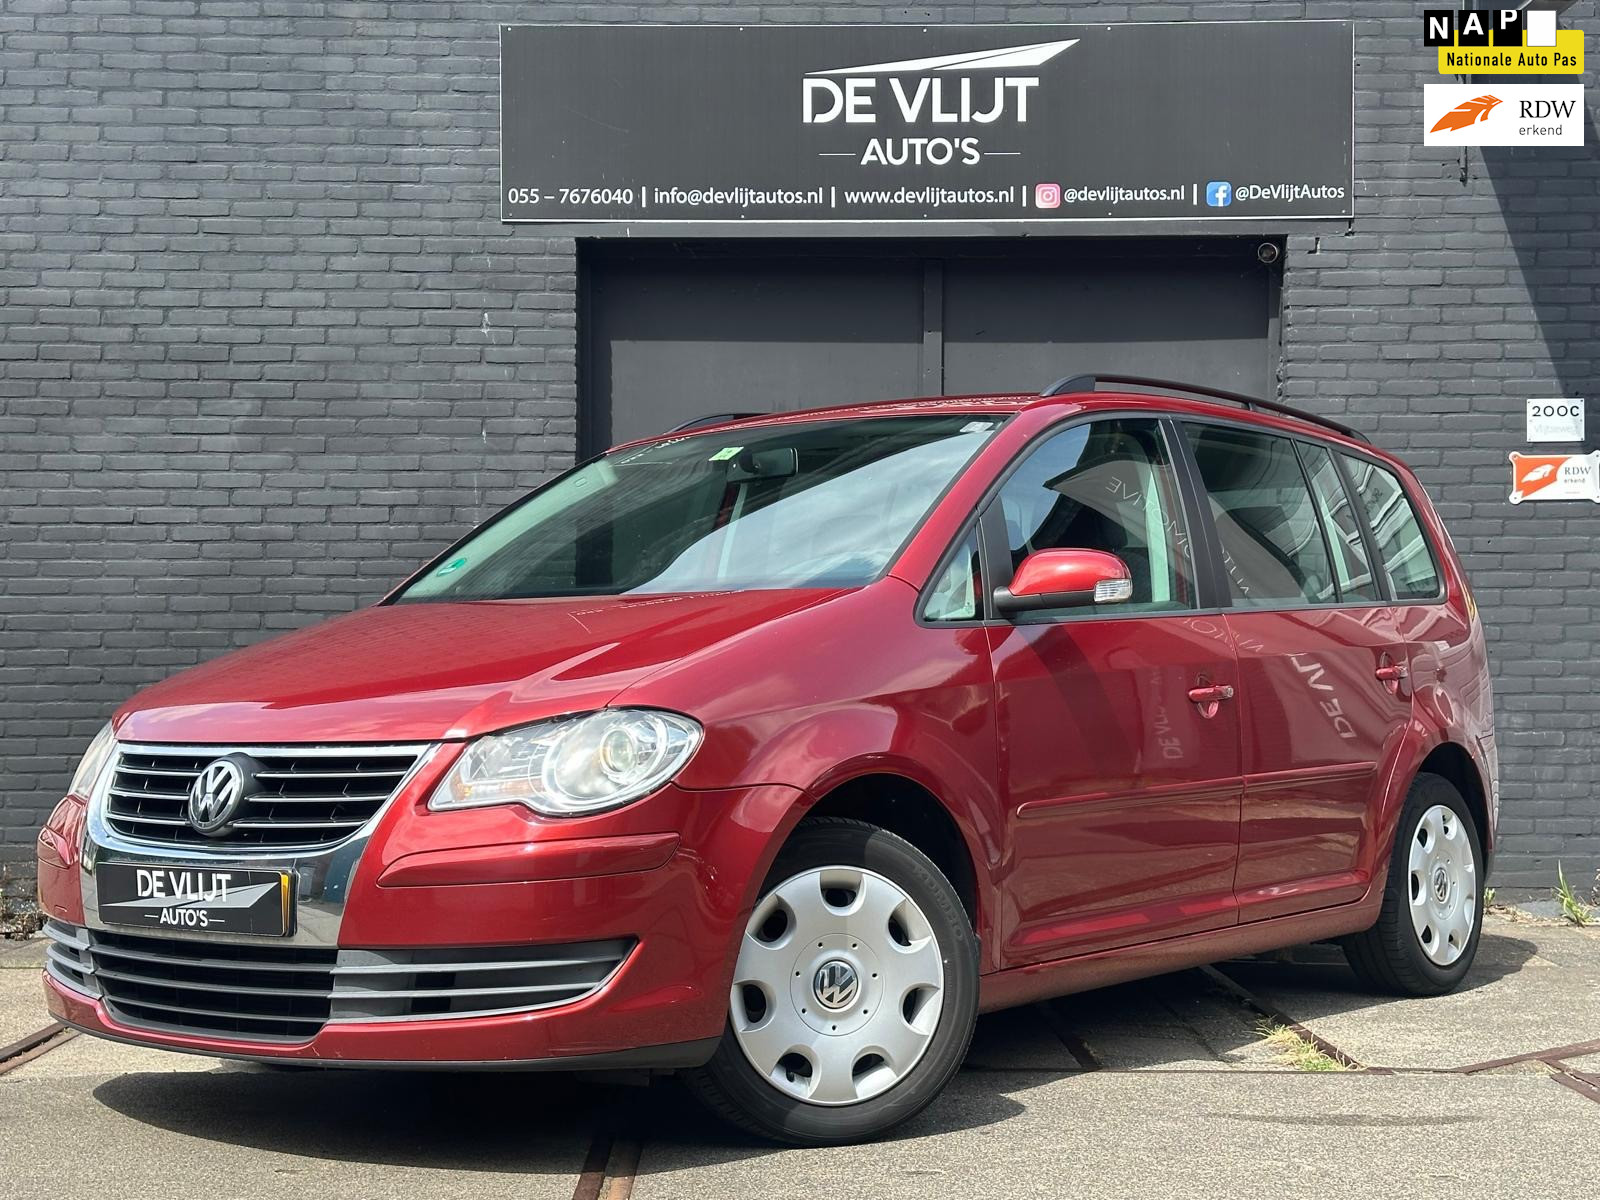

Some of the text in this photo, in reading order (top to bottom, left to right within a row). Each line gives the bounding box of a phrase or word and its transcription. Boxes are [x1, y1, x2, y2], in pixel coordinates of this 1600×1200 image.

[802, 76, 1040, 124] DE VLIJT
[860, 137, 981, 166] AUTO'S
[508, 187, 540, 204] 055
[558, 187, 634, 205] 7676040
[654, 186, 823, 208] info@devlijtautos.nl
[844, 185, 1014, 208] www.devlijtautos.nl
[1063, 184, 1185, 205] @devlijtautos.nl
[1235, 182, 1345, 203] @DeVlijtAutos
[1564, 466, 1592, 475] RDW
[136, 868, 232, 903] DE VLIJT
[159, 907, 209, 927] AUTO'S
